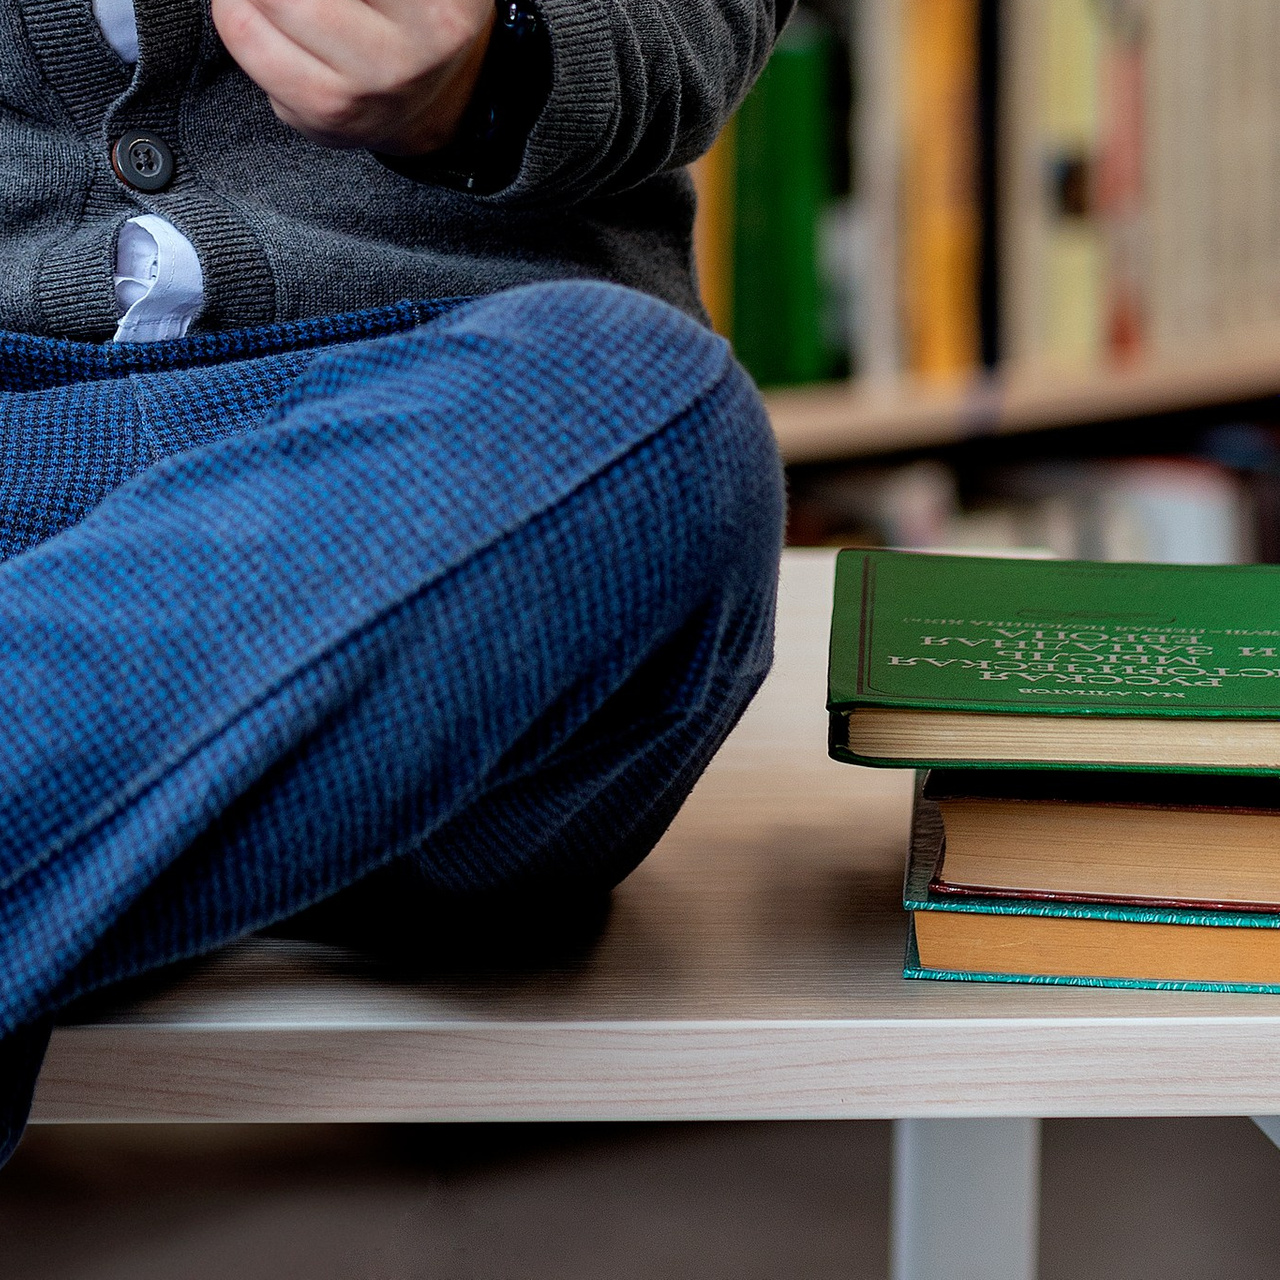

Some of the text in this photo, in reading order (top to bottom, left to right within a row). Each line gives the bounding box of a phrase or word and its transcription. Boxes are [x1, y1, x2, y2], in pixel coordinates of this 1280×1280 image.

[992, 628, 1203, 645] ЕВРОПА
[920, 635, 1278, 658] И ЗАПАДНАЯ
[996, 650, 1201, 666] МЫСЛЬ
[979, 670, 1224, 688] РУССКАЯ
